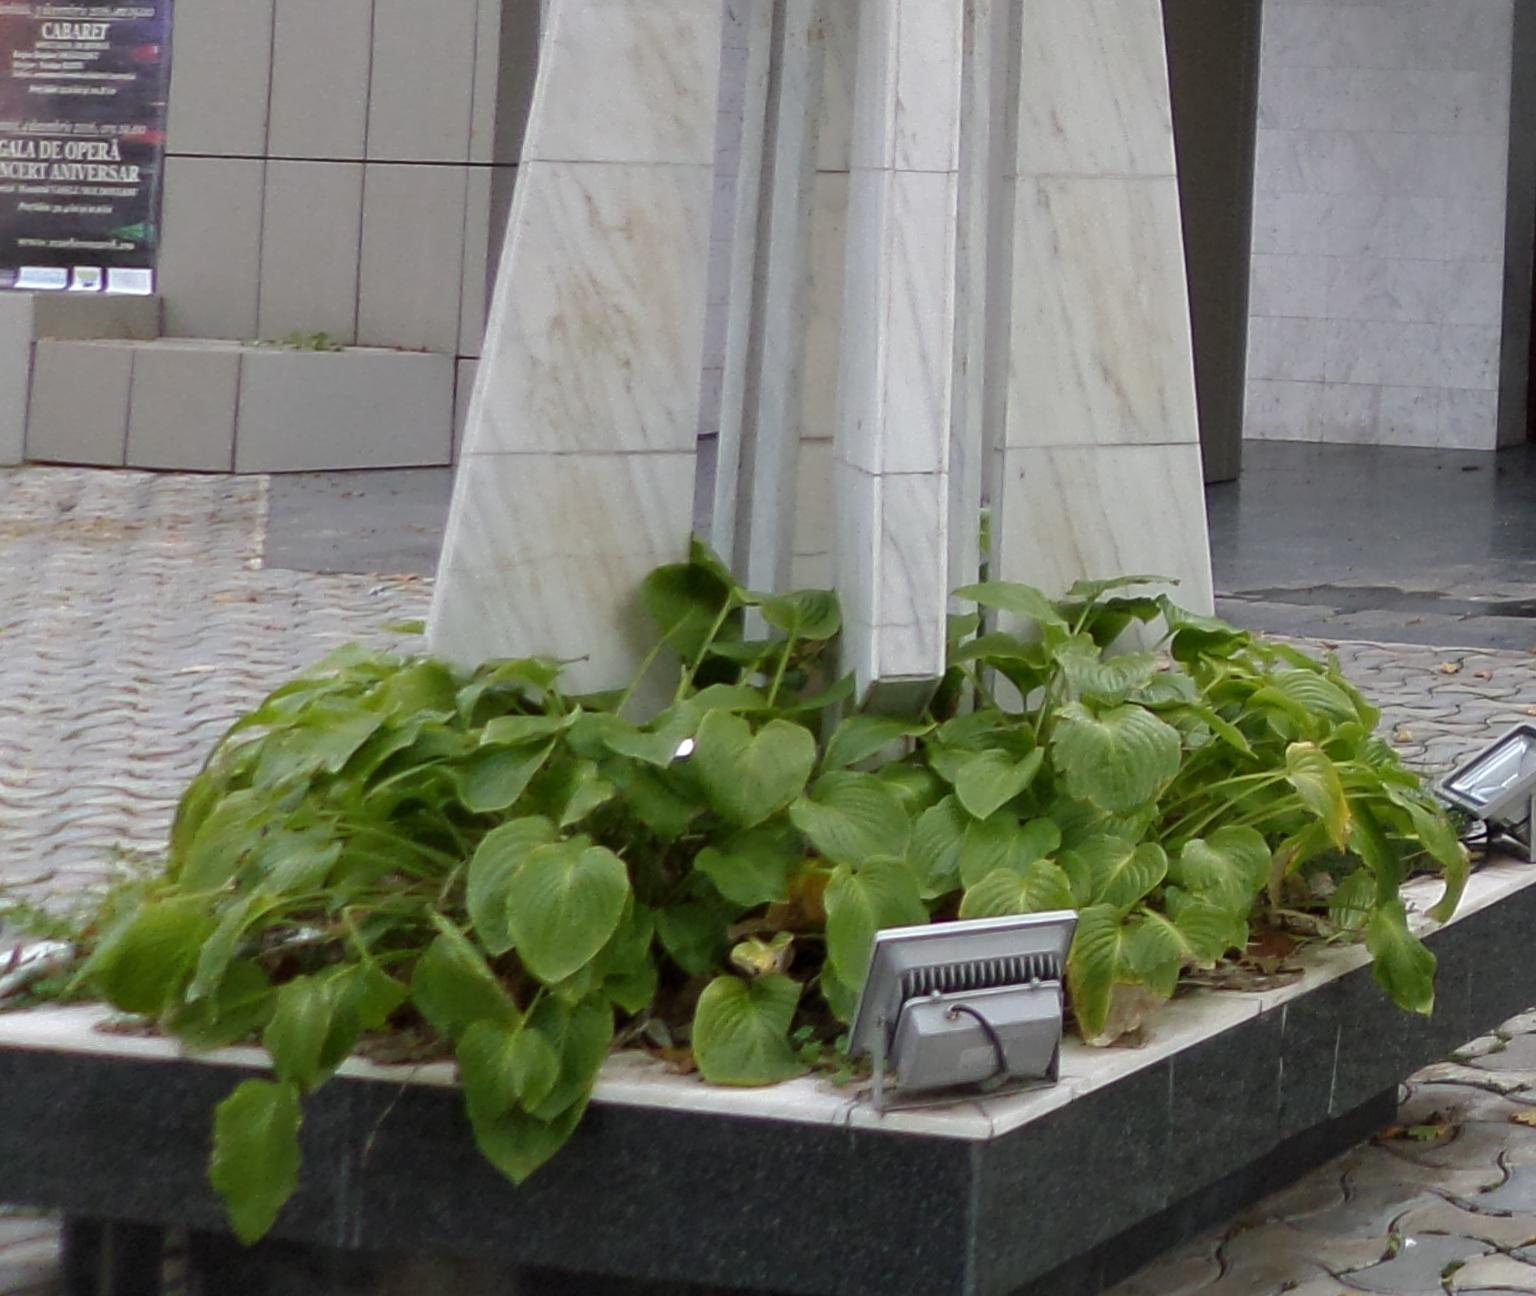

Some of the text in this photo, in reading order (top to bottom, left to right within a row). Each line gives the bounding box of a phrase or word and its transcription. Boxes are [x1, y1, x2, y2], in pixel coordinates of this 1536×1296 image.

[41, 22, 111, 41] CABARET
[40, 141, 63, 160] DE
[51, 163, 141, 183] ANIVERSAR
